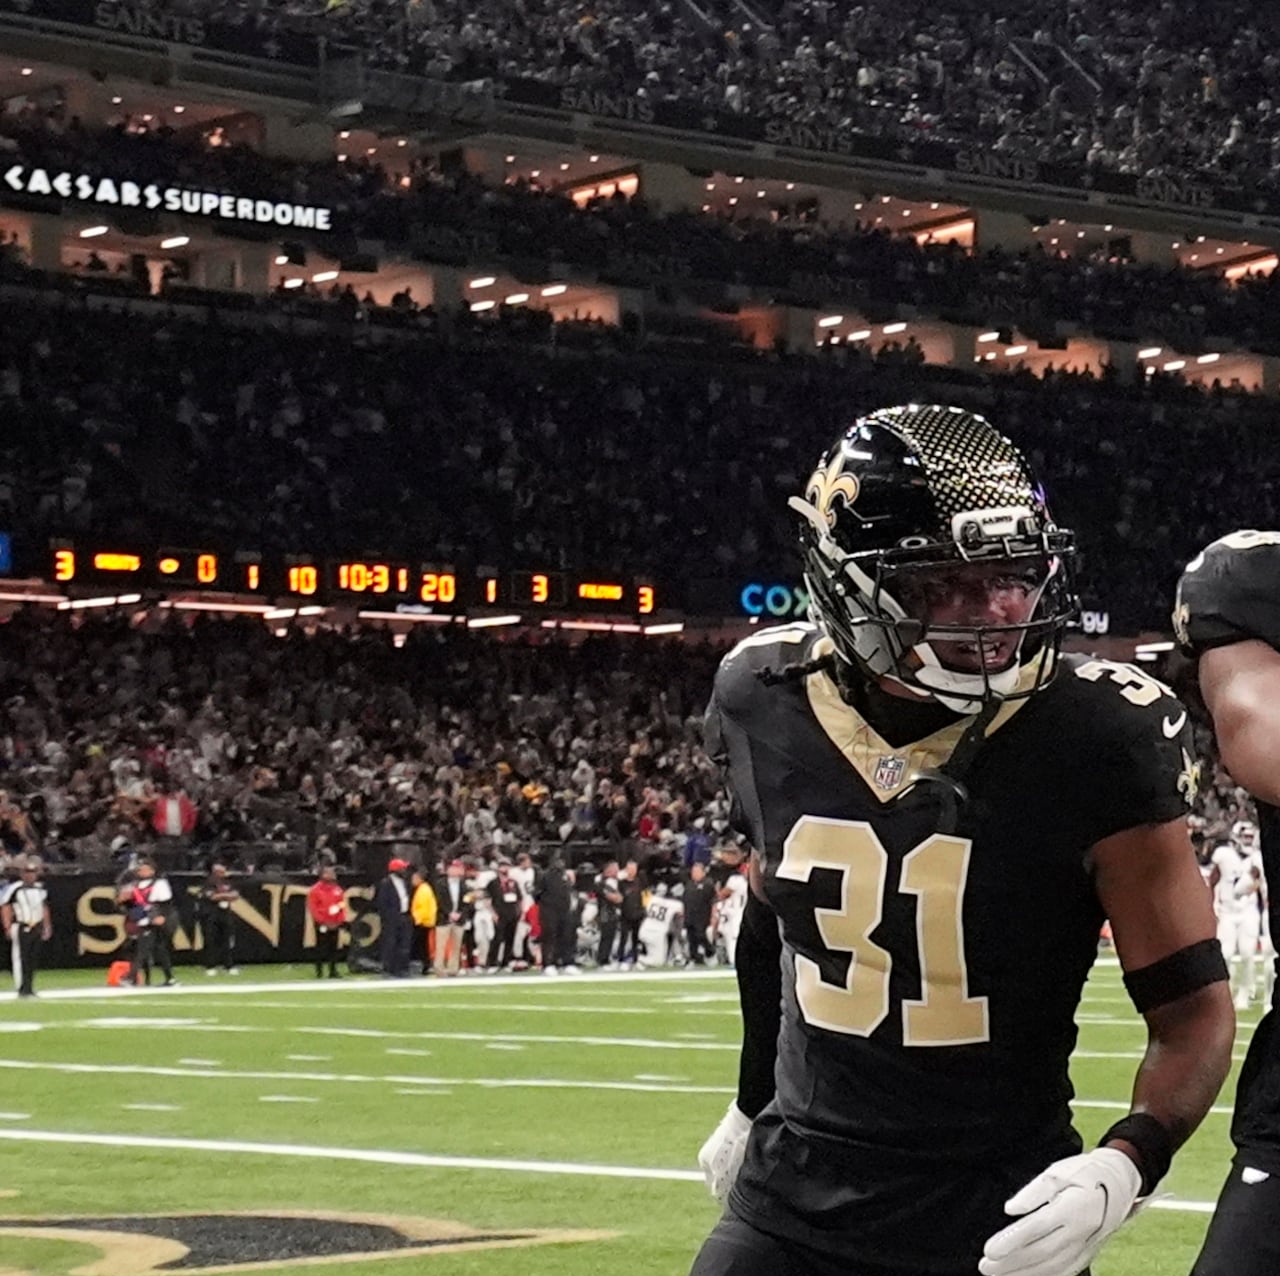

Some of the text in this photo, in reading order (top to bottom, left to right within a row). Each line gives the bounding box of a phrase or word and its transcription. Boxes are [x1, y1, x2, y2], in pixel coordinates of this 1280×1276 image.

[4, 165, 332, 230] CAESARS SUPERDOME
[55, 550, 75, 581] 3
[197, 554, 217, 583] 0
[248, 565, 259, 590] 1
[288, 566, 317, 595] 10
[420, 573, 456, 603] 20
[486, 579, 497, 603] 1
[532, 574, 549, 603] 3
[638, 586, 654, 614] 3
[775, 814, 992, 1049] 31
